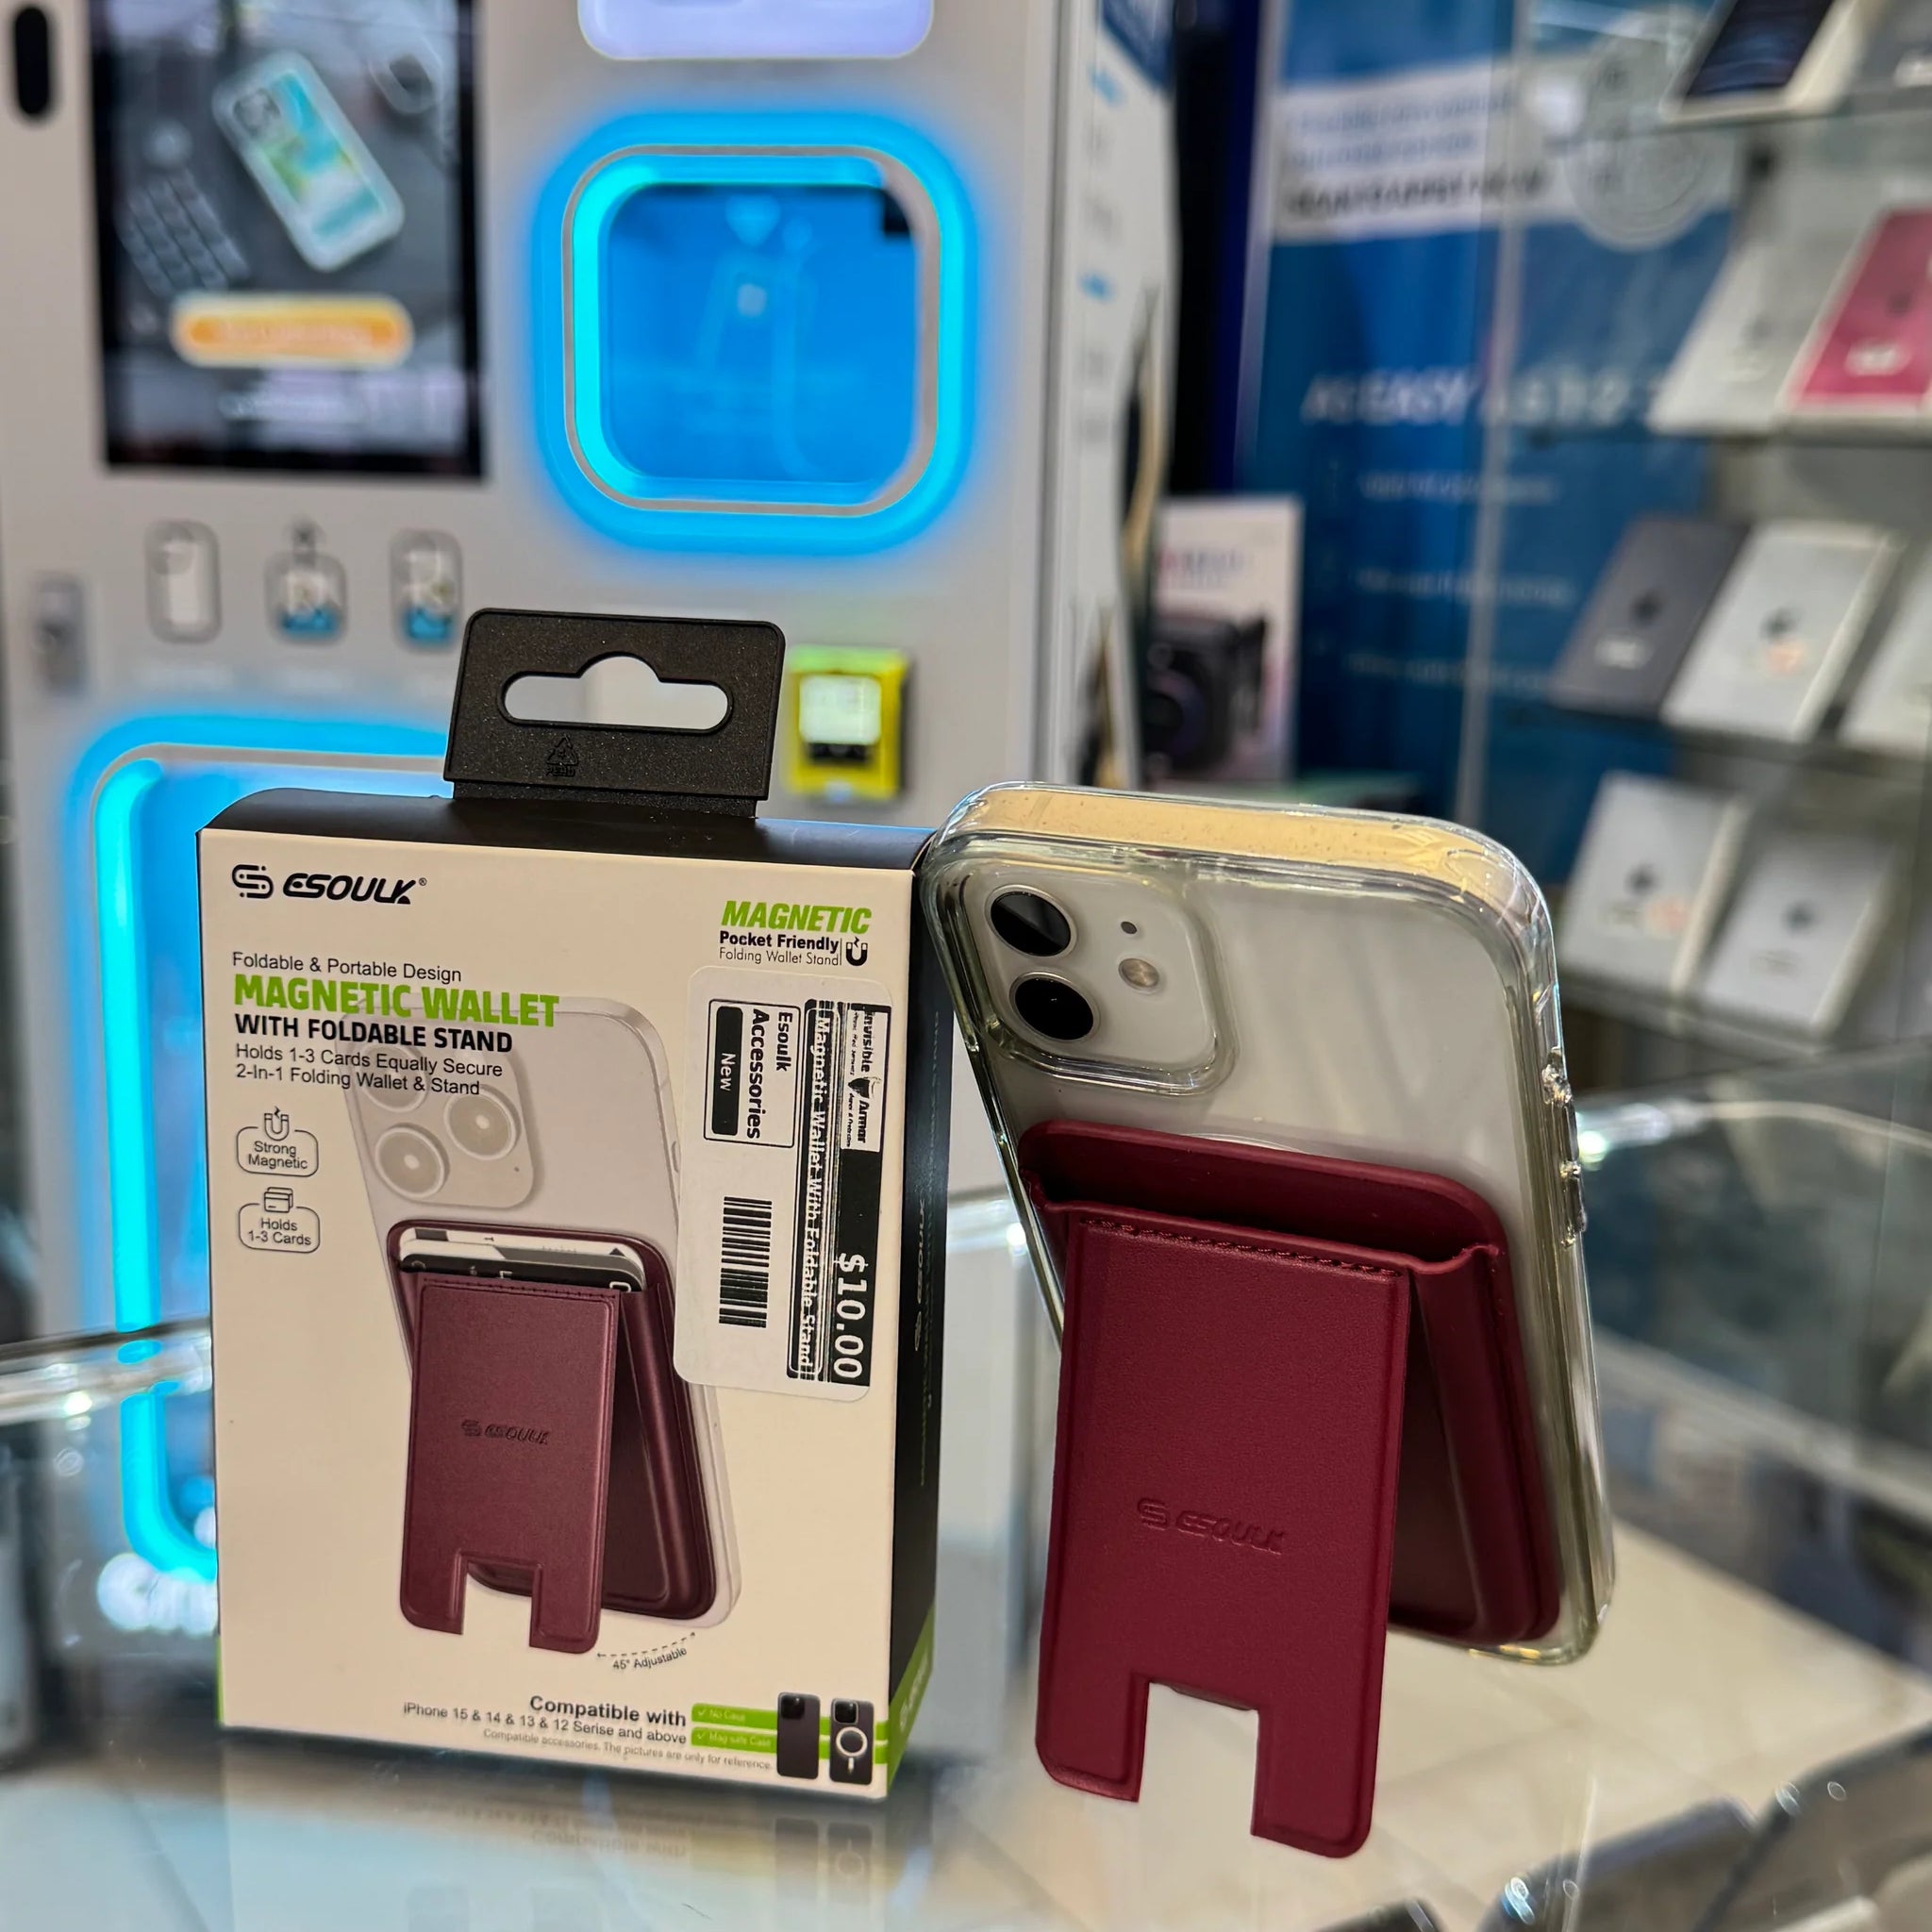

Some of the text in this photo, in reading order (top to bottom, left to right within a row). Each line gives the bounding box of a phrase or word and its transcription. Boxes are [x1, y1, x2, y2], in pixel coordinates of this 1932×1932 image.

[721, 900, 872, 934] MAGNETIC
[719, 947, 839, 966] Folding Wallet Stand
[720, 930, 839, 954] Pocket Friendly
[232, 952, 462, 984] Foldable & Portable Design
[234, 974, 560, 1027] MAGNETIC WALLET
[235, 1013, 513, 1053] WITH FOLDABLE STAND
[775, 1011, 792, 1072] Esoulk
[236, 1043, 503, 1077] Holds 1-3 Cards Equally Secure
[720, 1053, 736, 1091] New
[747, 1008, 770, 1140] Accessories
[236, 1063, 480, 1095] 2-In-1 Folding Wallet & Stand
[248, 1154, 308, 1169] Magnetic
[254, 1141, 297, 1158] Strong
[799, 1017, 830, 1367] Magnetic Wallet With Foldable Stand
[248, 1230, 311, 1246] 1-3 Cards
[261, 1217, 298, 1231] Holds
[834, 1253, 869, 1378] $10.00
[633, 1647, 688, 1669] Adjustable
[404, 1702, 687, 1744] iPhone 15 & 14 & 13 & 12 Serise and above
[530, 1695, 687, 1726] Compatible with
[484, 1728, 540, 1744] Compatible
[605, 1741, 621, 1754] The
[624, 1745, 663, 1760] pictures
[666, 1750, 682, 1759] are
[685, 1751, 706, 1764] only
[708, 1753, 722, 1764] for
